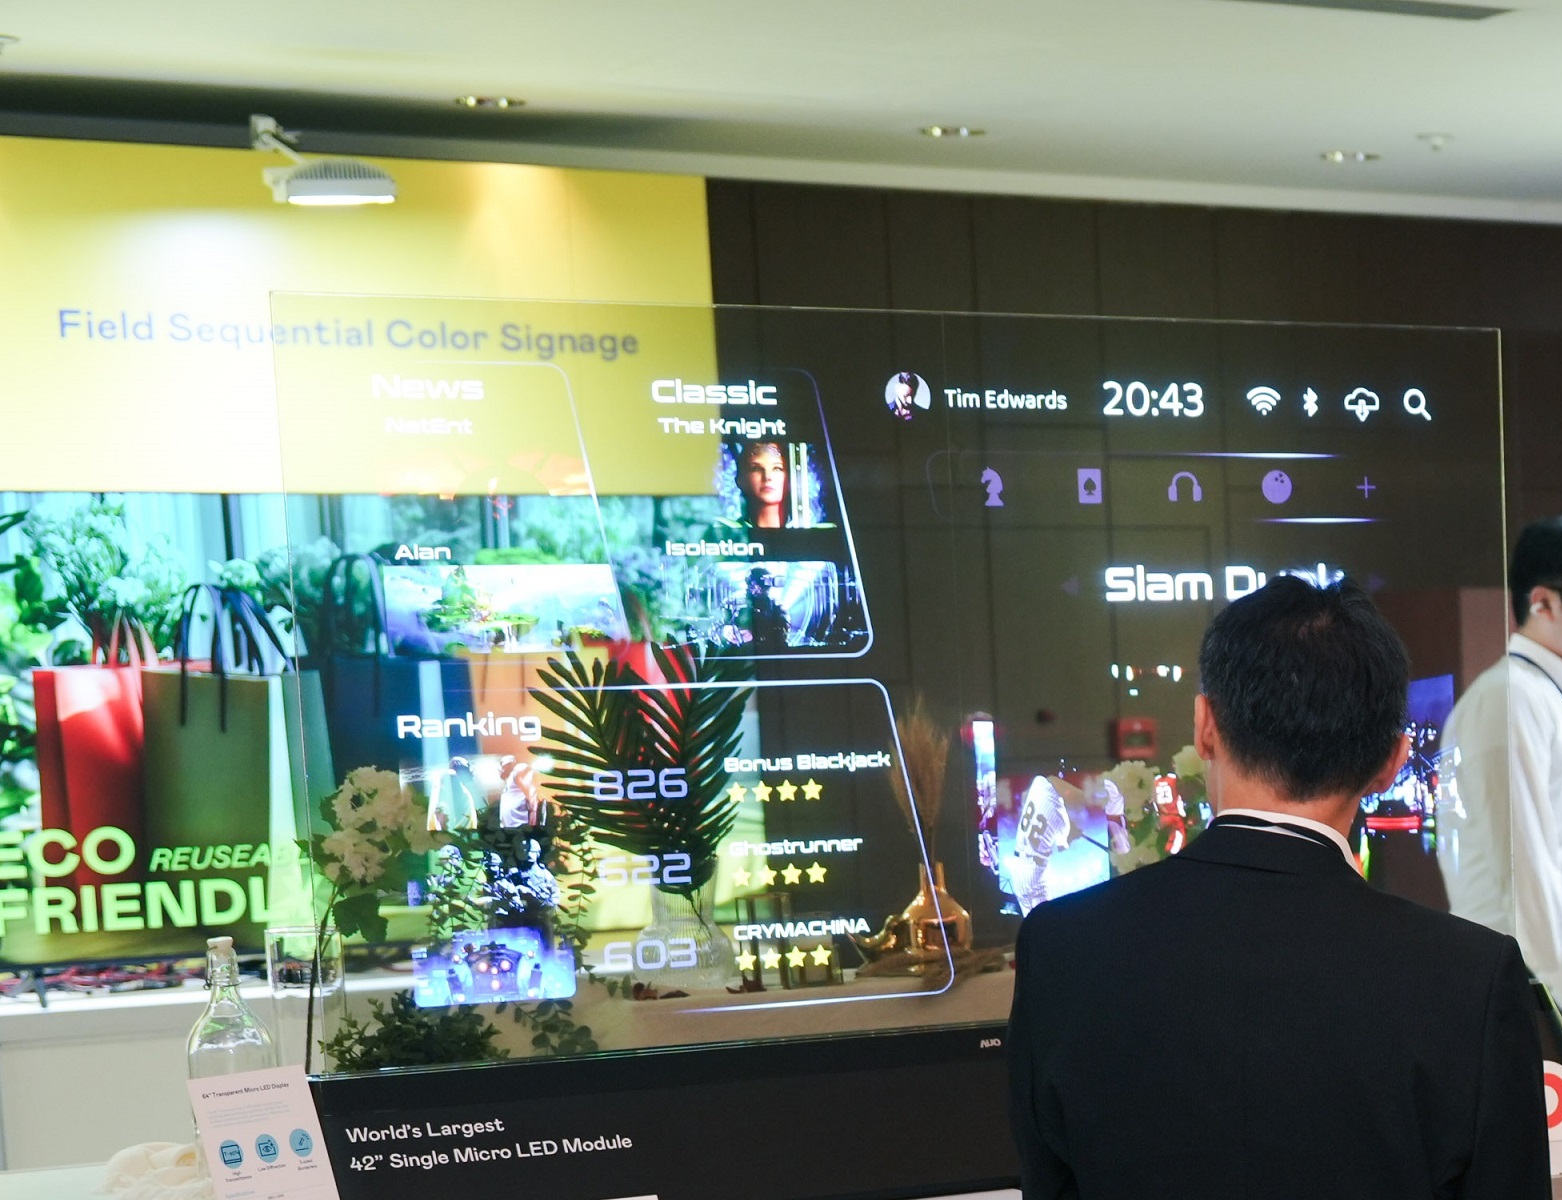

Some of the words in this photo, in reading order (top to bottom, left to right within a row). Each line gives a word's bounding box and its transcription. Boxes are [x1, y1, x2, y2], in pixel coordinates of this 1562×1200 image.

[58, 309, 154, 341] Field
[169, 313, 374, 349] Sequential
[386, 319, 488, 349] Color
[501, 322, 639, 361] Signage
[371, 373, 485, 400] News
[651, 378, 778, 405] Classic
[944, 388, 981, 408] Tim
[985, 389, 1068, 410] Edwards
[1102, 380, 1205, 418] 20:43
[657, 417, 704, 434] The
[709, 417, 787, 439] Knight
[394, 544, 451, 560] Alan
[665, 539, 765, 556] Isolation
[1105, 564, 1213, 601] Slam
[397, 711, 542, 741] Ranking
[724, 756, 793, 773] Bonus
[796, 750, 891, 772] Blackjack
[593, 767, 688, 801] 826
[1020, 801, 1048, 850] 82
[0, 826, 136, 879] ECO
[728, 837, 863, 856] Ghostrunner
[733, 918, 870, 941] CRYMACHINA
[603, 937, 698, 970] 603
[346, 1124, 422, 1143] World’s
[426, 1118, 505, 1138] Largest
[389, 1150, 450, 1170] Single
[453, 1147, 512, 1163] Micro
[515, 1140, 559, 1158] LED
[562, 1134, 633, 1154] Module
